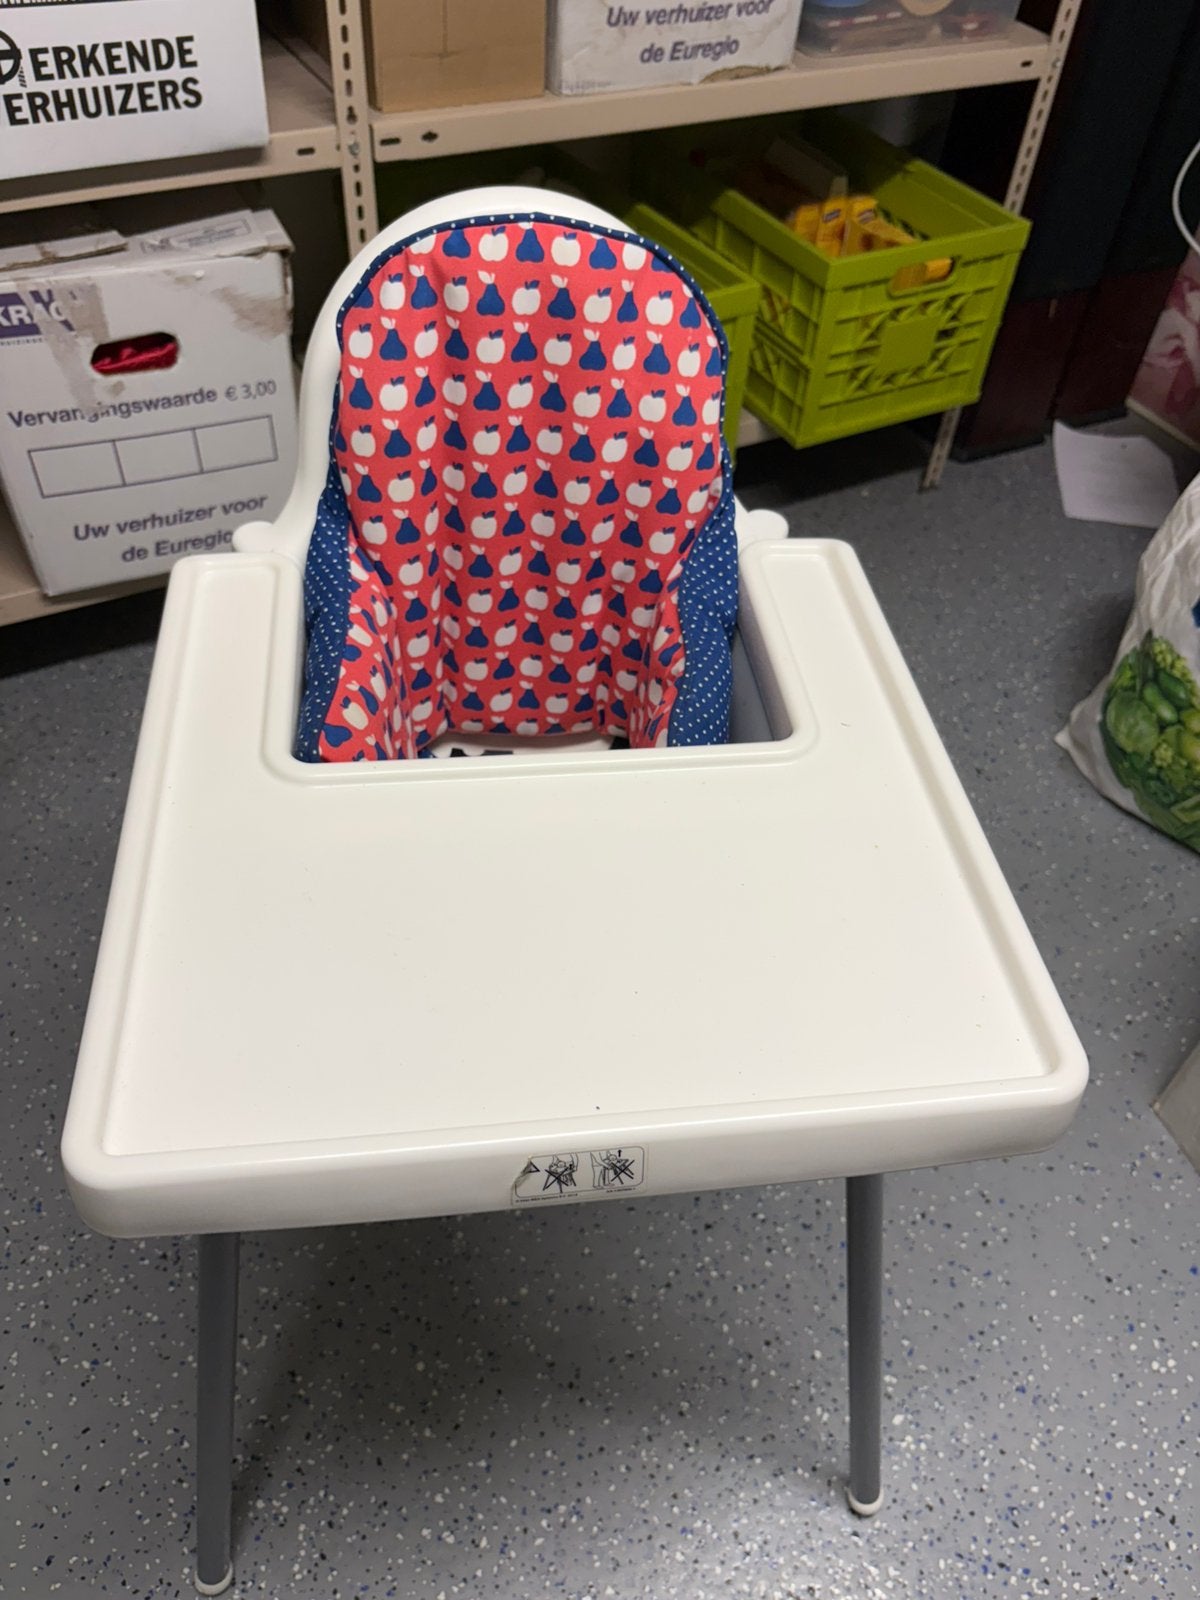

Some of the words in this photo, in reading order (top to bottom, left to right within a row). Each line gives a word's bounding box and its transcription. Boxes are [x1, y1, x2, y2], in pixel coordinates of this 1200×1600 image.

[606, 7, 640, 28] Uw
[645, 2, 733, 25] verhuizer
[736, 0, 774, 17] voor
[28, 35, 198, 82] ERKENDE
[640, 43, 664, 63] de
[670, 36, 740, 62] Euregio
[243, 380, 277, 399] 3,00
[73, 524, 109, 541] Uw
[116, 503, 216, 534] verhuizer
[221, 495, 268, 515] voor
[121, 546, 148, 563] de
[155, 530, 233, 556] Euregio
